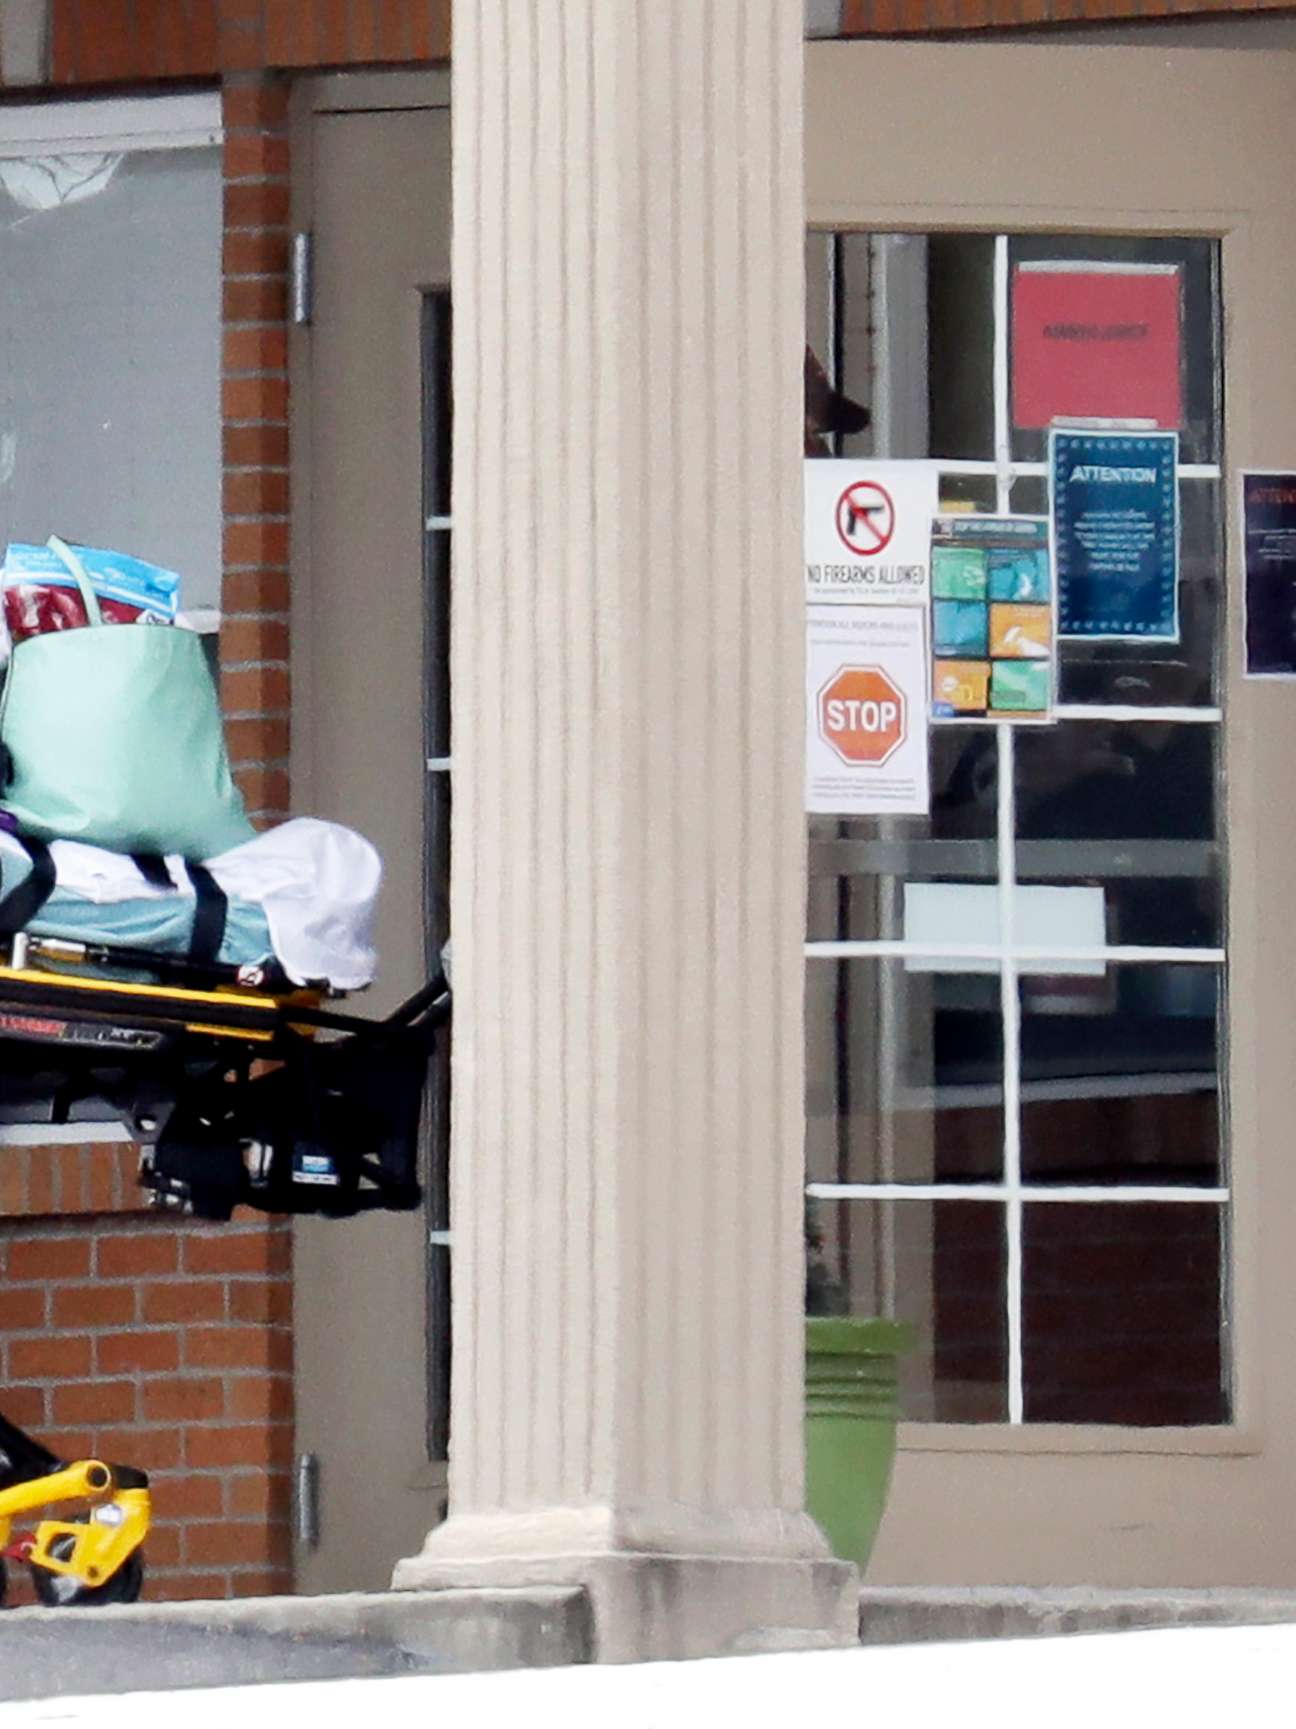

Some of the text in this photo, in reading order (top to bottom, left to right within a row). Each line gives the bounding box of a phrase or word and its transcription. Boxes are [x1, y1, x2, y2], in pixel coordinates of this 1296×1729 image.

[1069, 465, 1157, 483] ATTENTION
[807, 564, 926, 586] NO FIREARMS ALLOWED
[827, 700, 897, 732] STOP
